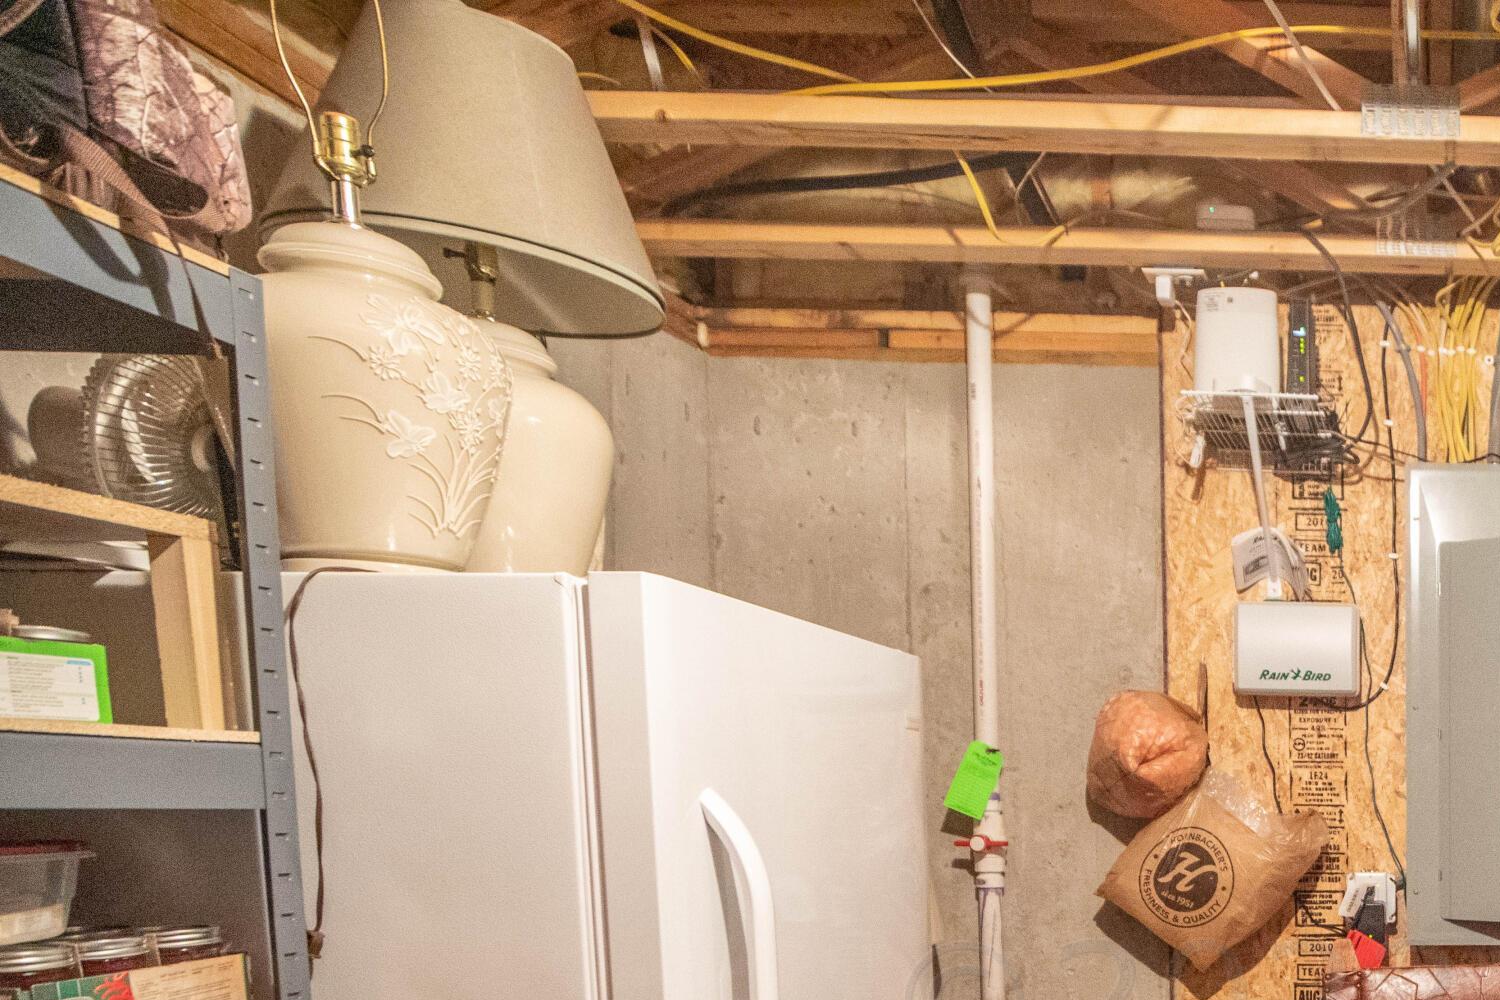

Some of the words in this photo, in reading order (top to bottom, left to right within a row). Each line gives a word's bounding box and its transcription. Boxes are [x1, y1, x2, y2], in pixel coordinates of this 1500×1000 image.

[1303, 669, 1332, 682] BIRD
[1143, 868, 1171, 920] FRESHNESS
[1172, 914, 1180, 923] &
[1182, 899, 1223, 924] QUALITY
